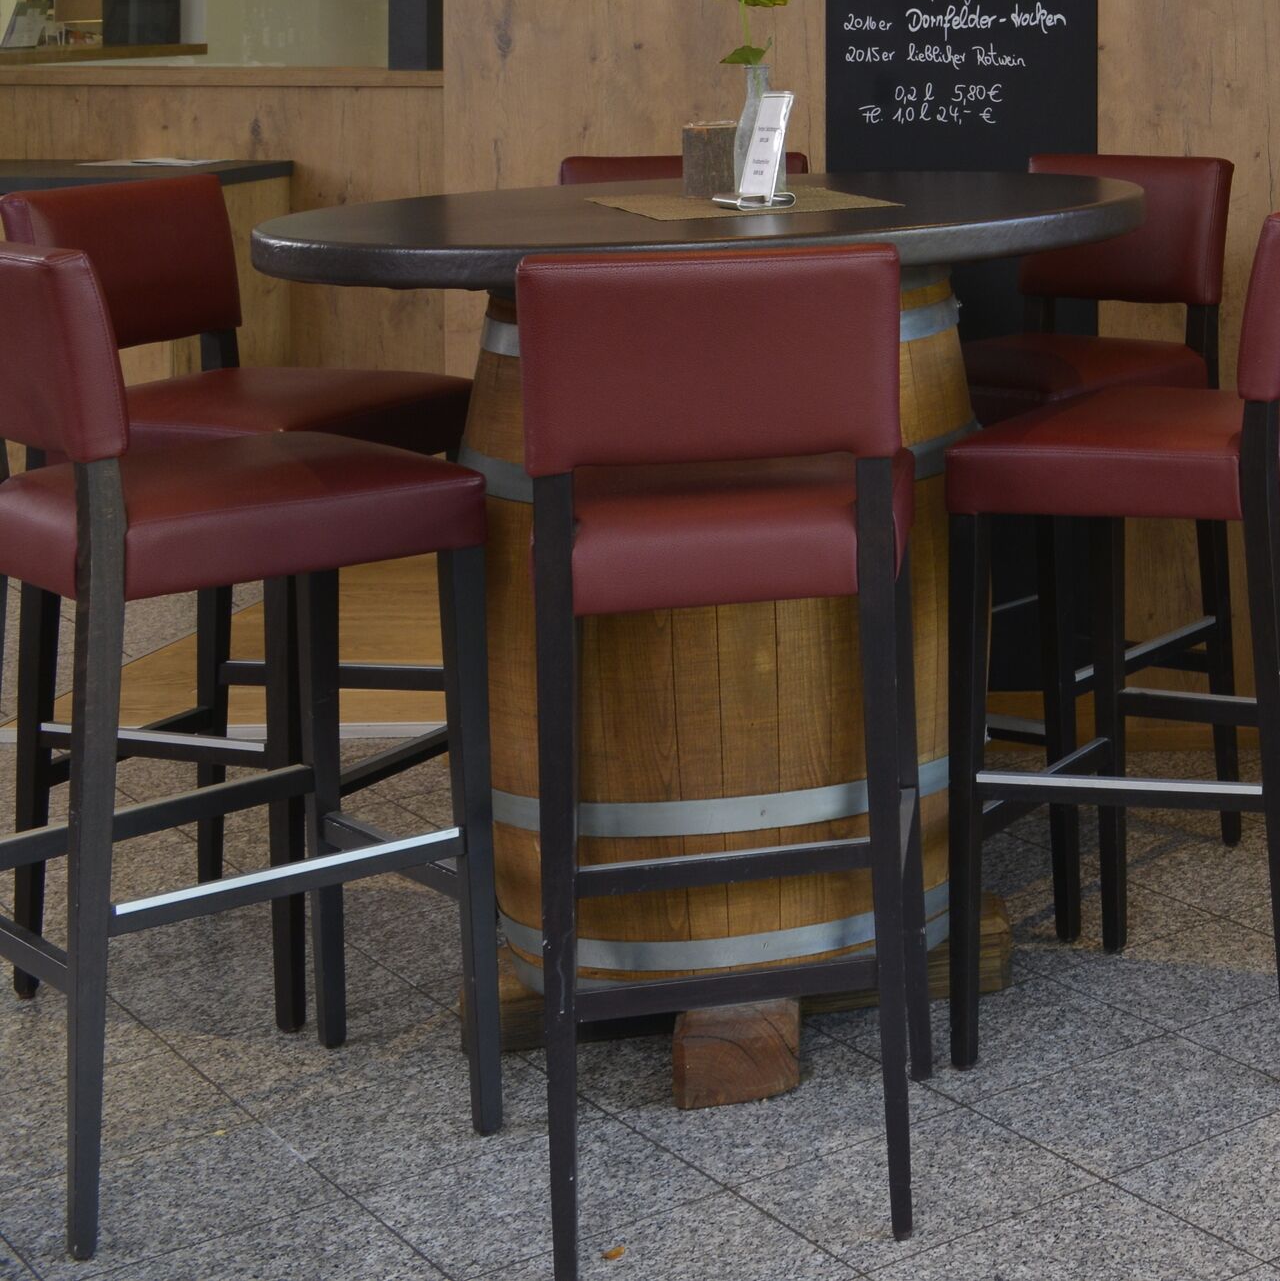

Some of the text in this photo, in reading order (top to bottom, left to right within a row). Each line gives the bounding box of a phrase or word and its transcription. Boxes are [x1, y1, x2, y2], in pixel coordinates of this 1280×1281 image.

[843, 13, 893, 31] 2016er
[1010, 2, 1067, 34] trocken
[845, 43, 1026, 70] 2015er lieblicher Rotwein
[894, 85, 917, 105] 0,2
[892, 106, 915, 125] 1,0
[979, 107, 996, 124] €
